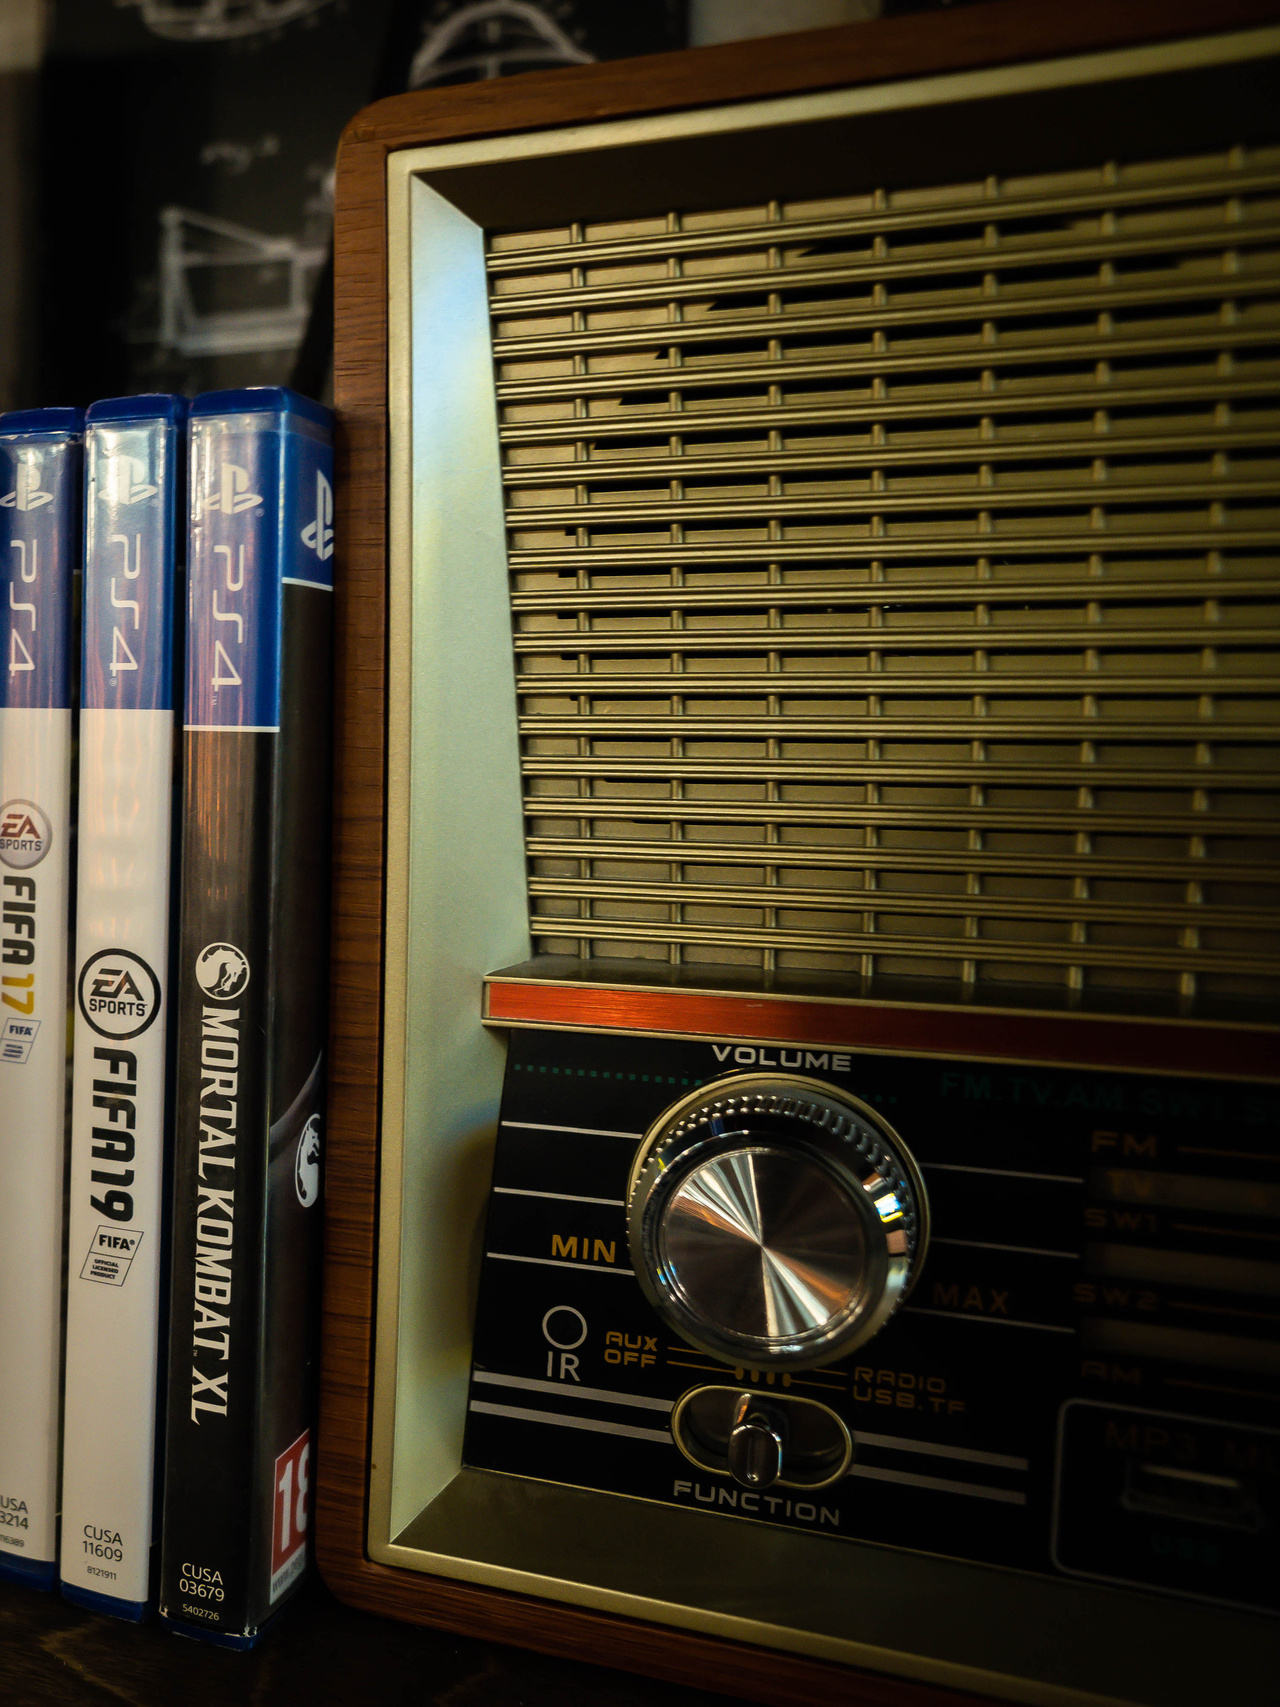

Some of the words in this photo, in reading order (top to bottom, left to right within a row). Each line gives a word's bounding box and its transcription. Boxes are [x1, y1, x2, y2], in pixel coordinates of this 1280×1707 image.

[9, 538, 38, 678] PS4
[109, 533, 142, 678] PS4
[210, 544, 245, 693] PS4
[0, 813, 42, 839] EA
[0, 838, 43, 851] SPORTS
[2, 875, 37, 966] FIFA
[1, 973, 35, 1015] 17
[89, 968, 145, 1001] EA
[88, 998, 146, 1017] SPORTS
[711, 1045, 852, 1072] VOLUME
[196, 1003, 240, 1186] MORTAL
[1089, 1129, 1161, 1159] FM
[1082, 1206, 1161, 1235] SW1
[551, 1234, 616, 1263] MIN
[191, 1181, 237, 1361] KOMBAT
[933, 1282, 1010, 1315] MAX
[1071, 1282, 1161, 1312] SW2
[605, 1331, 658, 1351] AUX
[546, 1350, 581, 1382] IR
[604, 1349, 657, 1368] OFF
[854, 1366, 947, 1394] RADIO
[1080, 1360, 1143, 1388] AM
[191, 1364, 230, 1426] XL
[1103, 1418, 1200, 1464] MP3
[673, 1479, 840, 1527] FUNCTION
[83, 1524, 123, 1546] CUSA
[82, 1540, 123, 1562] 11609
[86, 1565, 117, 1580] 8121911
[181, 1562, 224, 1585] CUSA
[179, 1578, 225, 1602] 03679
[182, 1603, 220, 1621] 5402726
